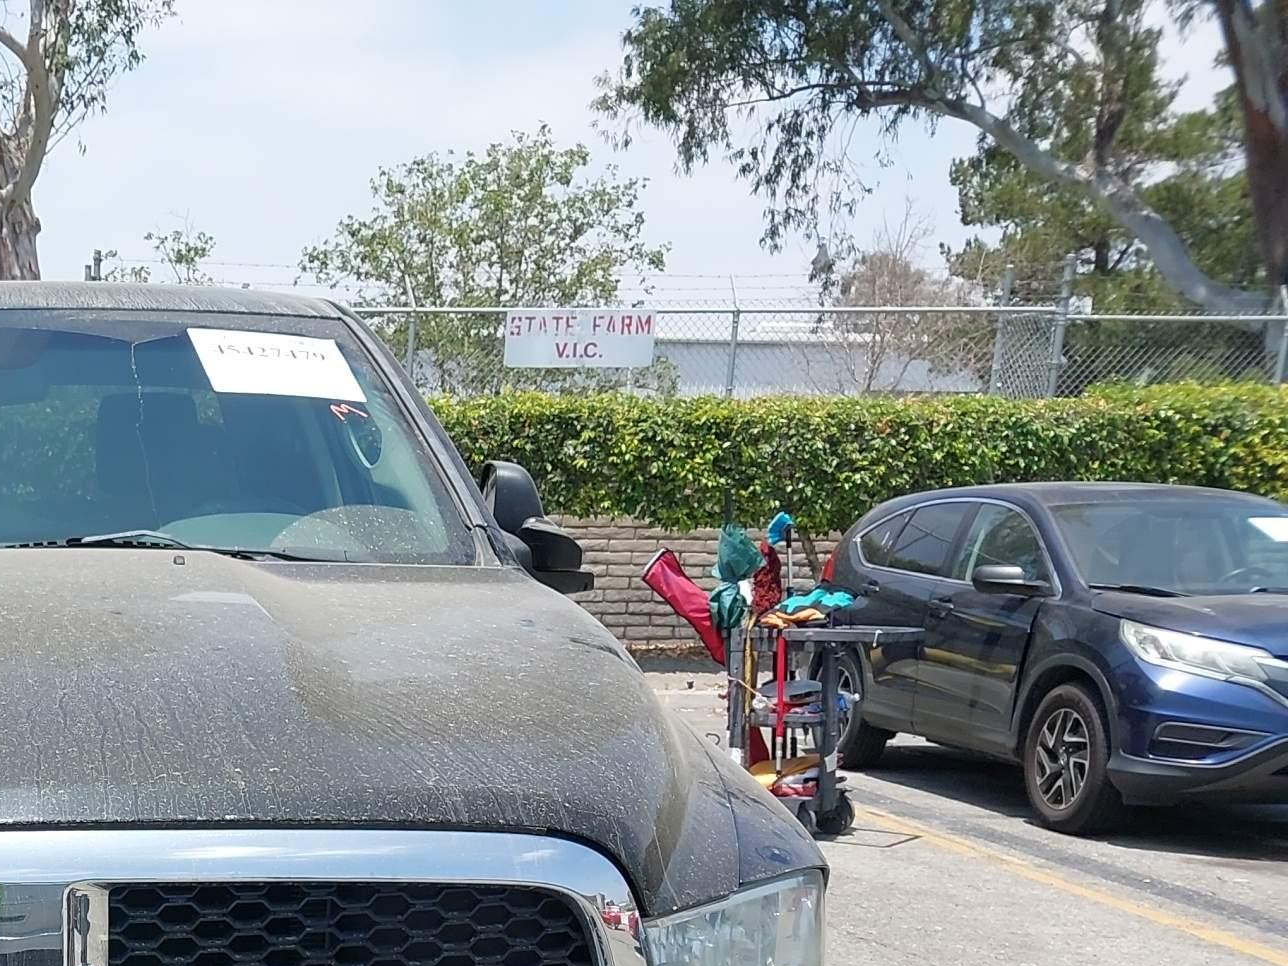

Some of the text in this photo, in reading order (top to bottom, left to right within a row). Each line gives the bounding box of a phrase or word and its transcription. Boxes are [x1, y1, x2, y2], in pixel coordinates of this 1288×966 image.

[510, 314, 653, 337] STATE FARM
[555, 341, 604, 359] V.I.C.
